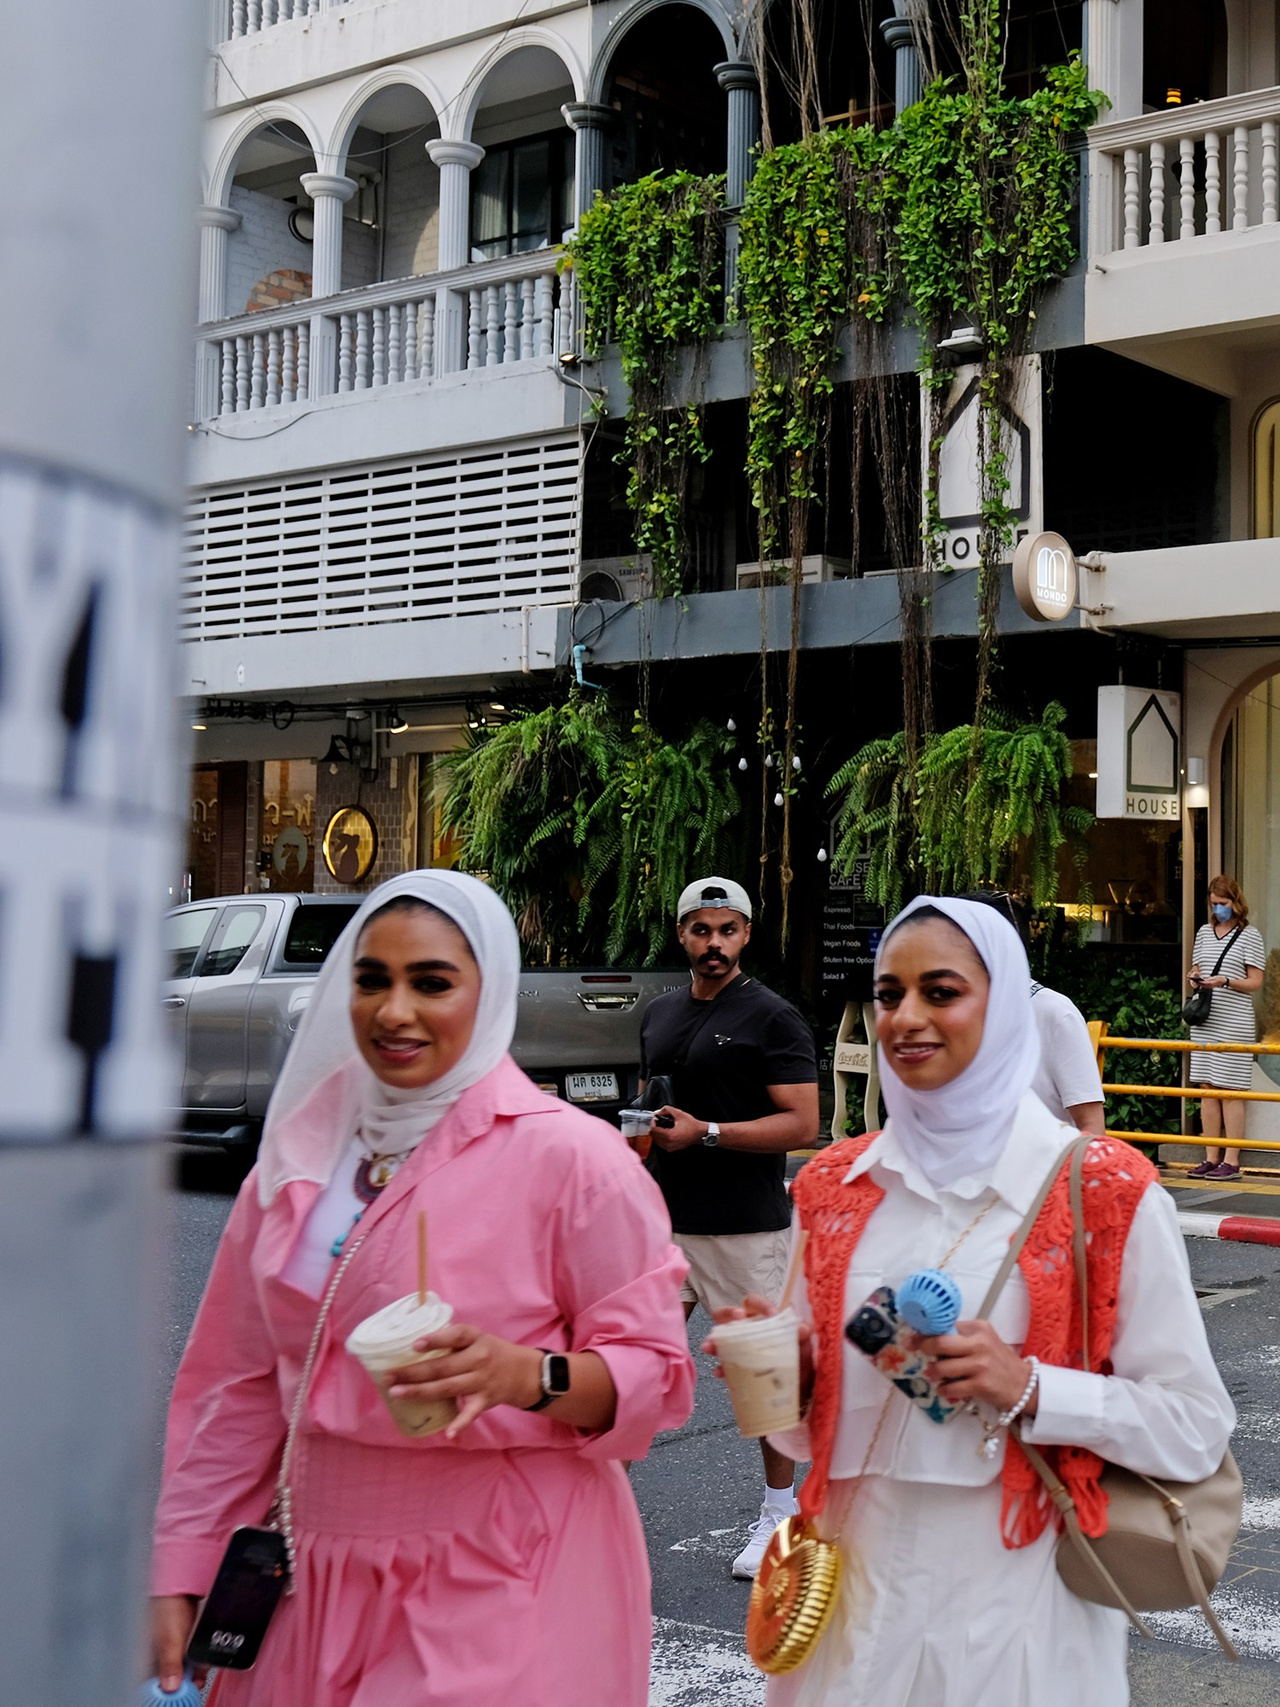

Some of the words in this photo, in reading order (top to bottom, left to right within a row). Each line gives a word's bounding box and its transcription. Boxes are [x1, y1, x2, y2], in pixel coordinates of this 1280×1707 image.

[1037, 587, 1067, 603] MONDO
[1126, 798, 1177, 815] HOUSE
[823, 906, 851, 914] Espresso
[823, 940, 841, 948] Vegan
[590, 1075, 613, 1088] 6325
